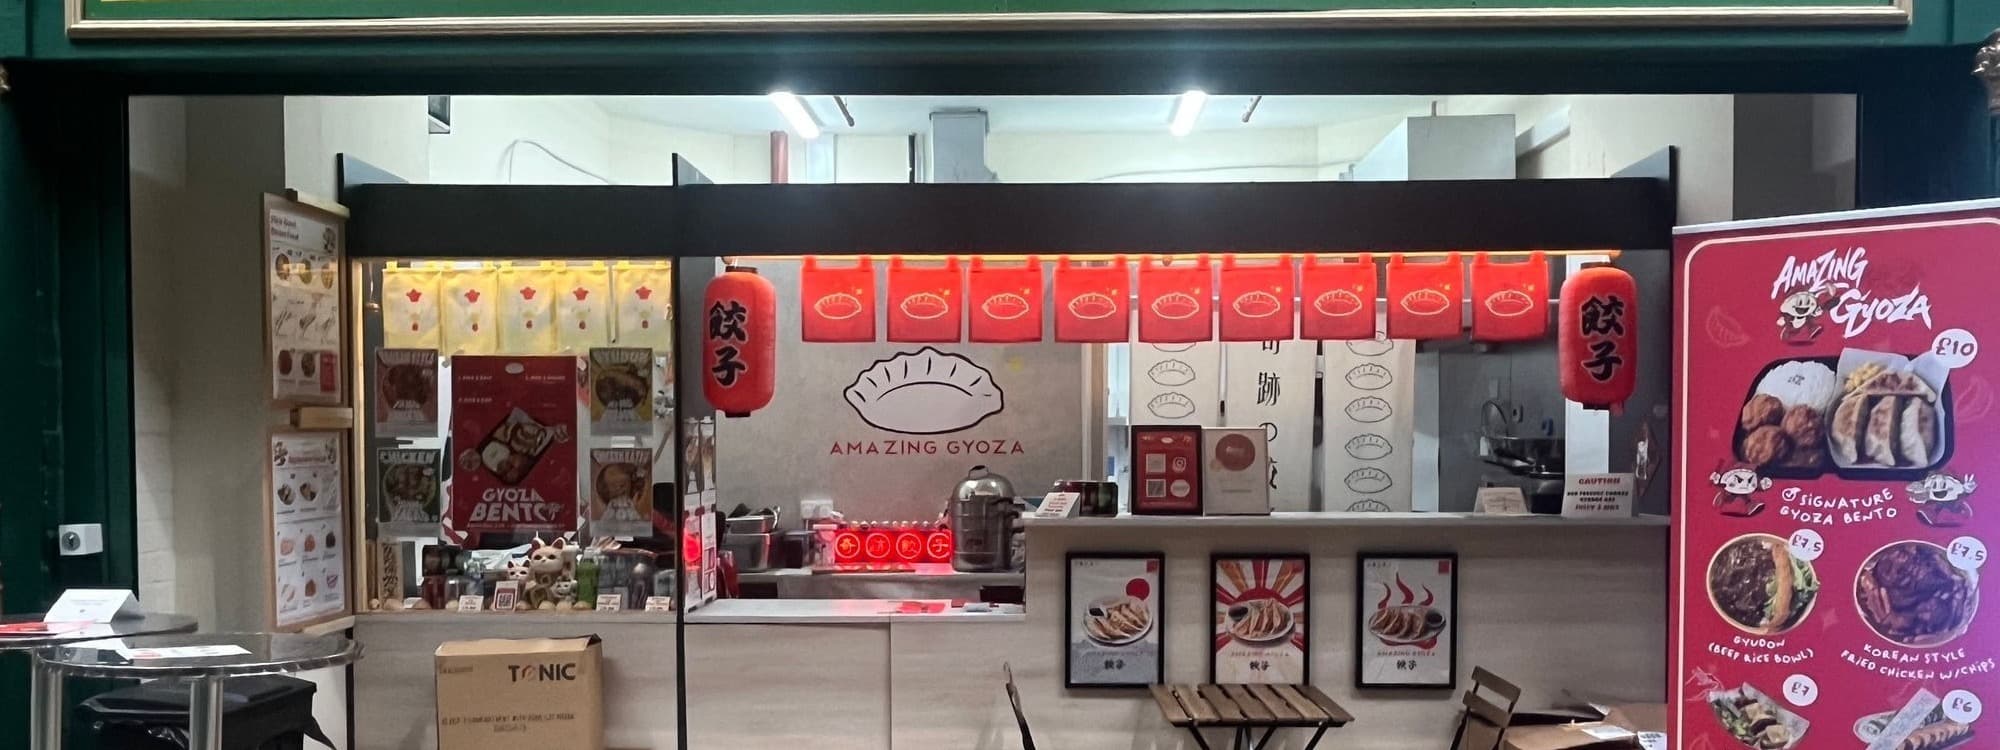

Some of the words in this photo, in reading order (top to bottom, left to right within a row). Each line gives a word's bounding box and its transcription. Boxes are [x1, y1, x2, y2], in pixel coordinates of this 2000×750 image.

[1771, 247, 1869, 300] AMAZING
[1829, 283, 1932, 339] GYOZA
[709, 300, 748, 386] 餃子
[1581, 295, 1625, 382] 餃子
[1936, 337, 1974, 356] £10
[830, 440, 937, 455] AMAZING
[946, 440, 1024, 455] GYOZA
[482, 487, 545, 502] GYOZA
[1780, 506, 1833, 525] GYOZA
[1844, 508, 1897, 524] BENTO
[1733, 636, 1785, 649] GYUDON
[1708, 642, 1740, 660] (BEEF
[1774, 648, 1814, 663] BOWL)
[1863, 643, 1919, 663] KOREAN
[1924, 648, 1965, 664] STYLE
[508, 663, 576, 682] TONIC
[1791, 682, 1809, 695] £7
[1952, 697, 1972, 713] £6
